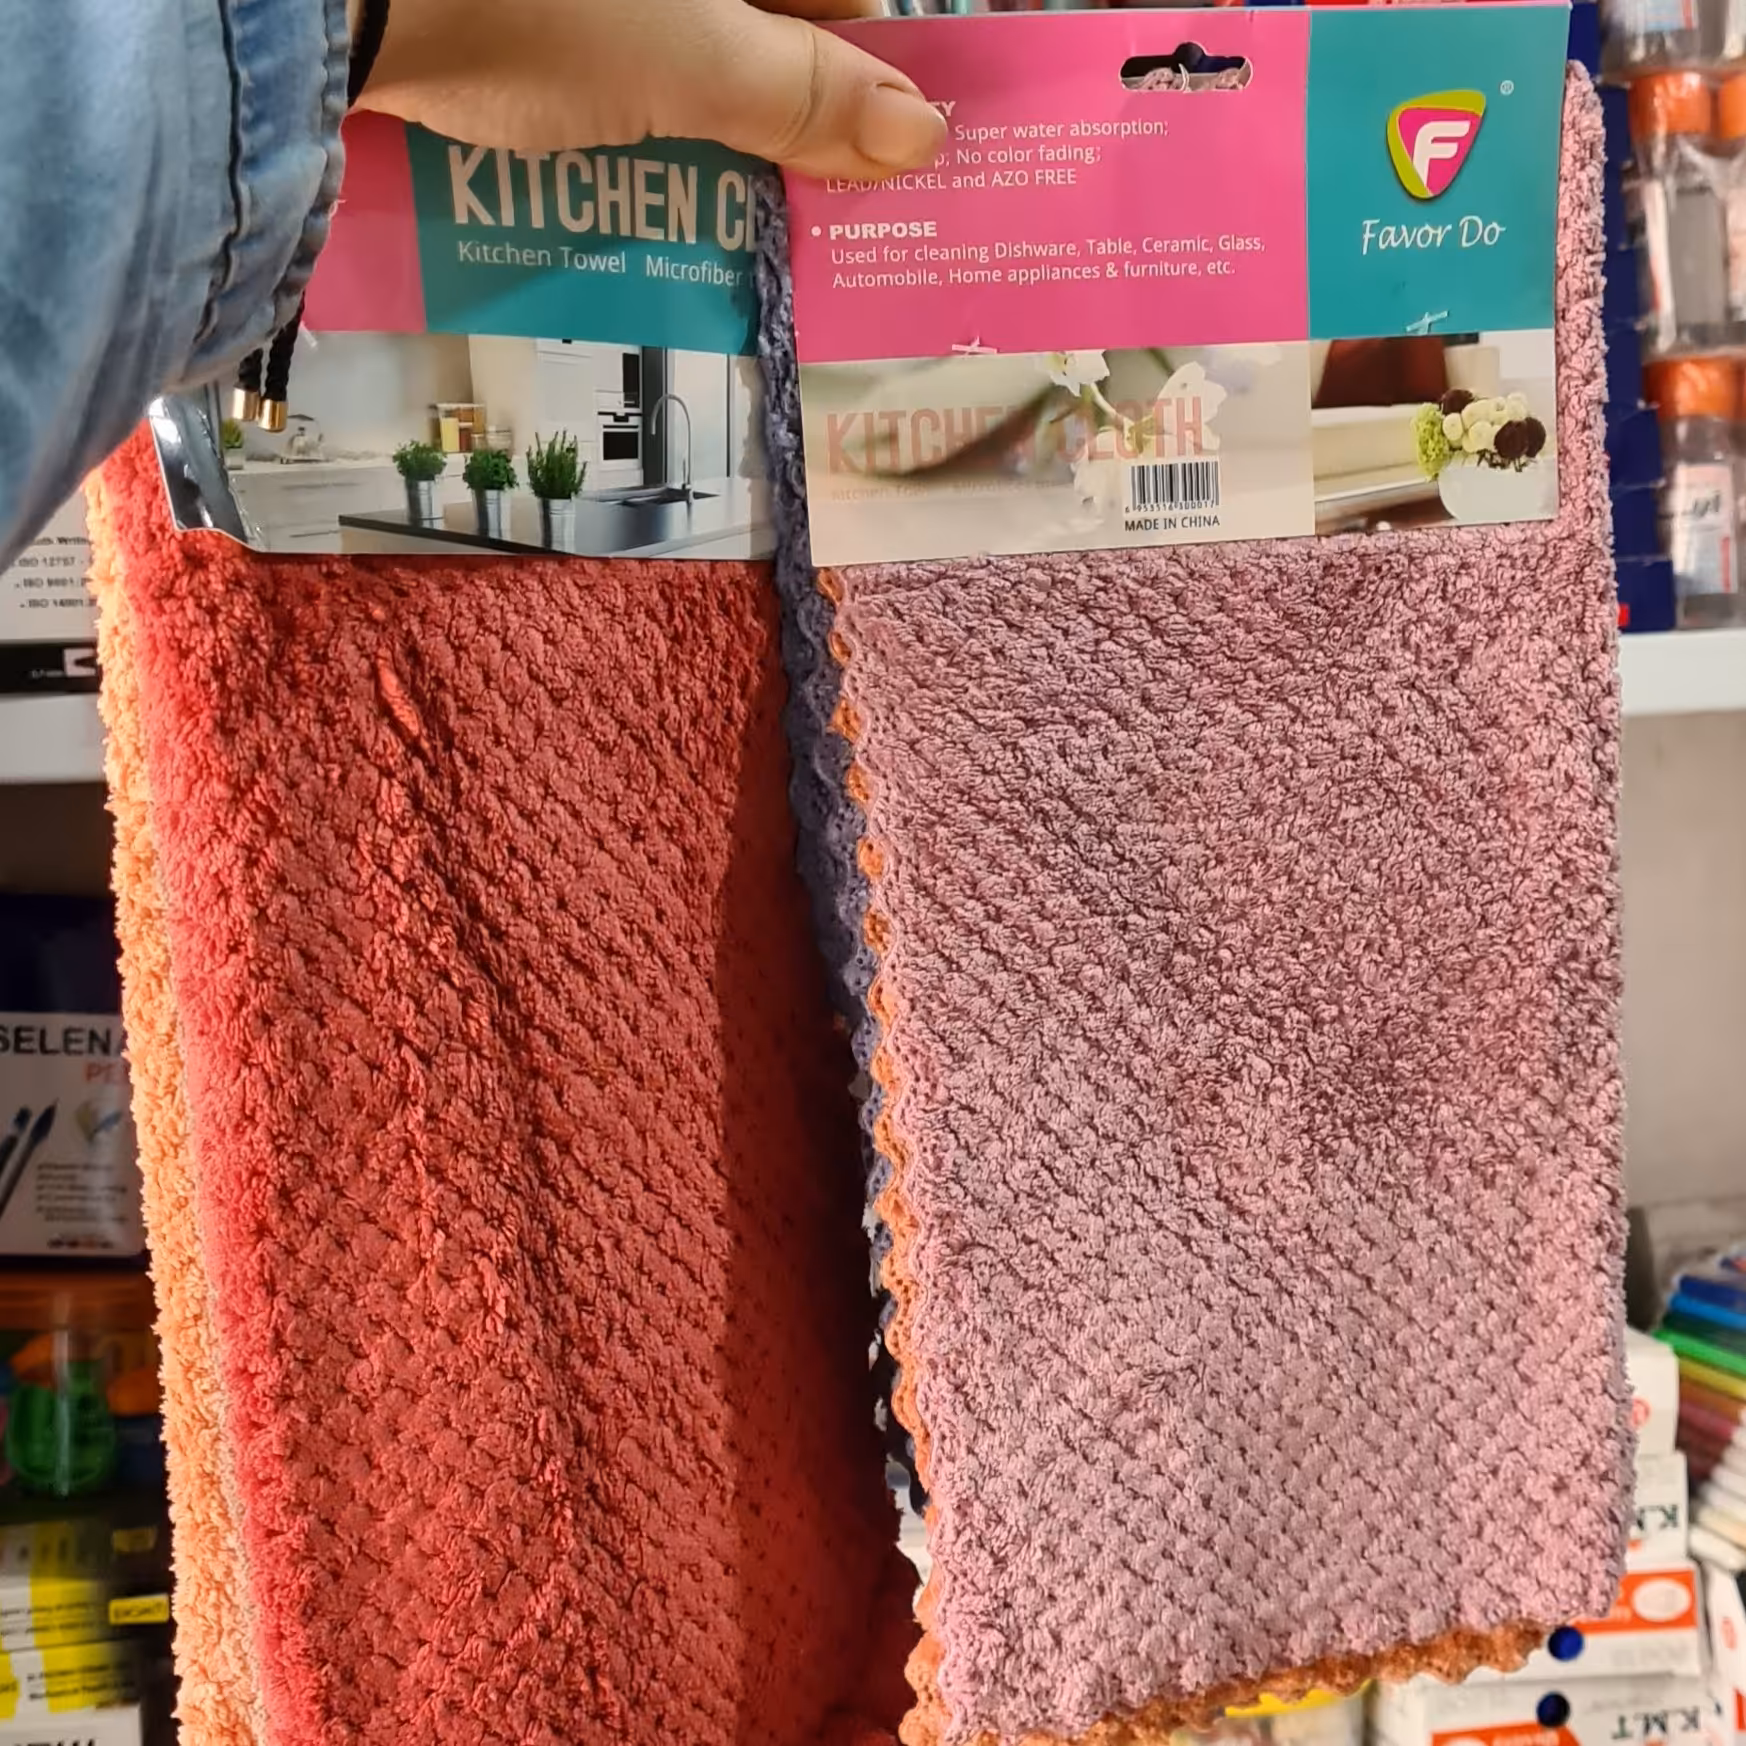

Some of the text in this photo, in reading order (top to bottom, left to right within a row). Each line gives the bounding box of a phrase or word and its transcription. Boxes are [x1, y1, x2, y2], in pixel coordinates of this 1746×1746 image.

[954, 118, 1169, 144] Super water absorption;
[956, 149, 982, 165] No
[987, 146, 1033, 164] color
[1038, 144, 1101, 165] fading;
[952, 172, 985, 189] and
[991, 169, 1029, 187] AZO
[1034, 168, 1077, 185] FREE
[447, 144, 698, 245] KITCHEN
[829, 221, 938, 241] PURPOSE
[1361, 214, 1506, 256] Favor Do
[831, 233, 1265, 265] Used for cleaning Dishware, Table, Ceramic, Glass,
[457, 240, 551, 267] Kitchen
[561, 246, 626, 273] Towel
[646, 254, 744, 287] Microfiber
[832, 259, 1236, 289] Automobile, Home appliances & furniture, etc.
[1124, 515, 1220, 532] MADE IN CHINA
